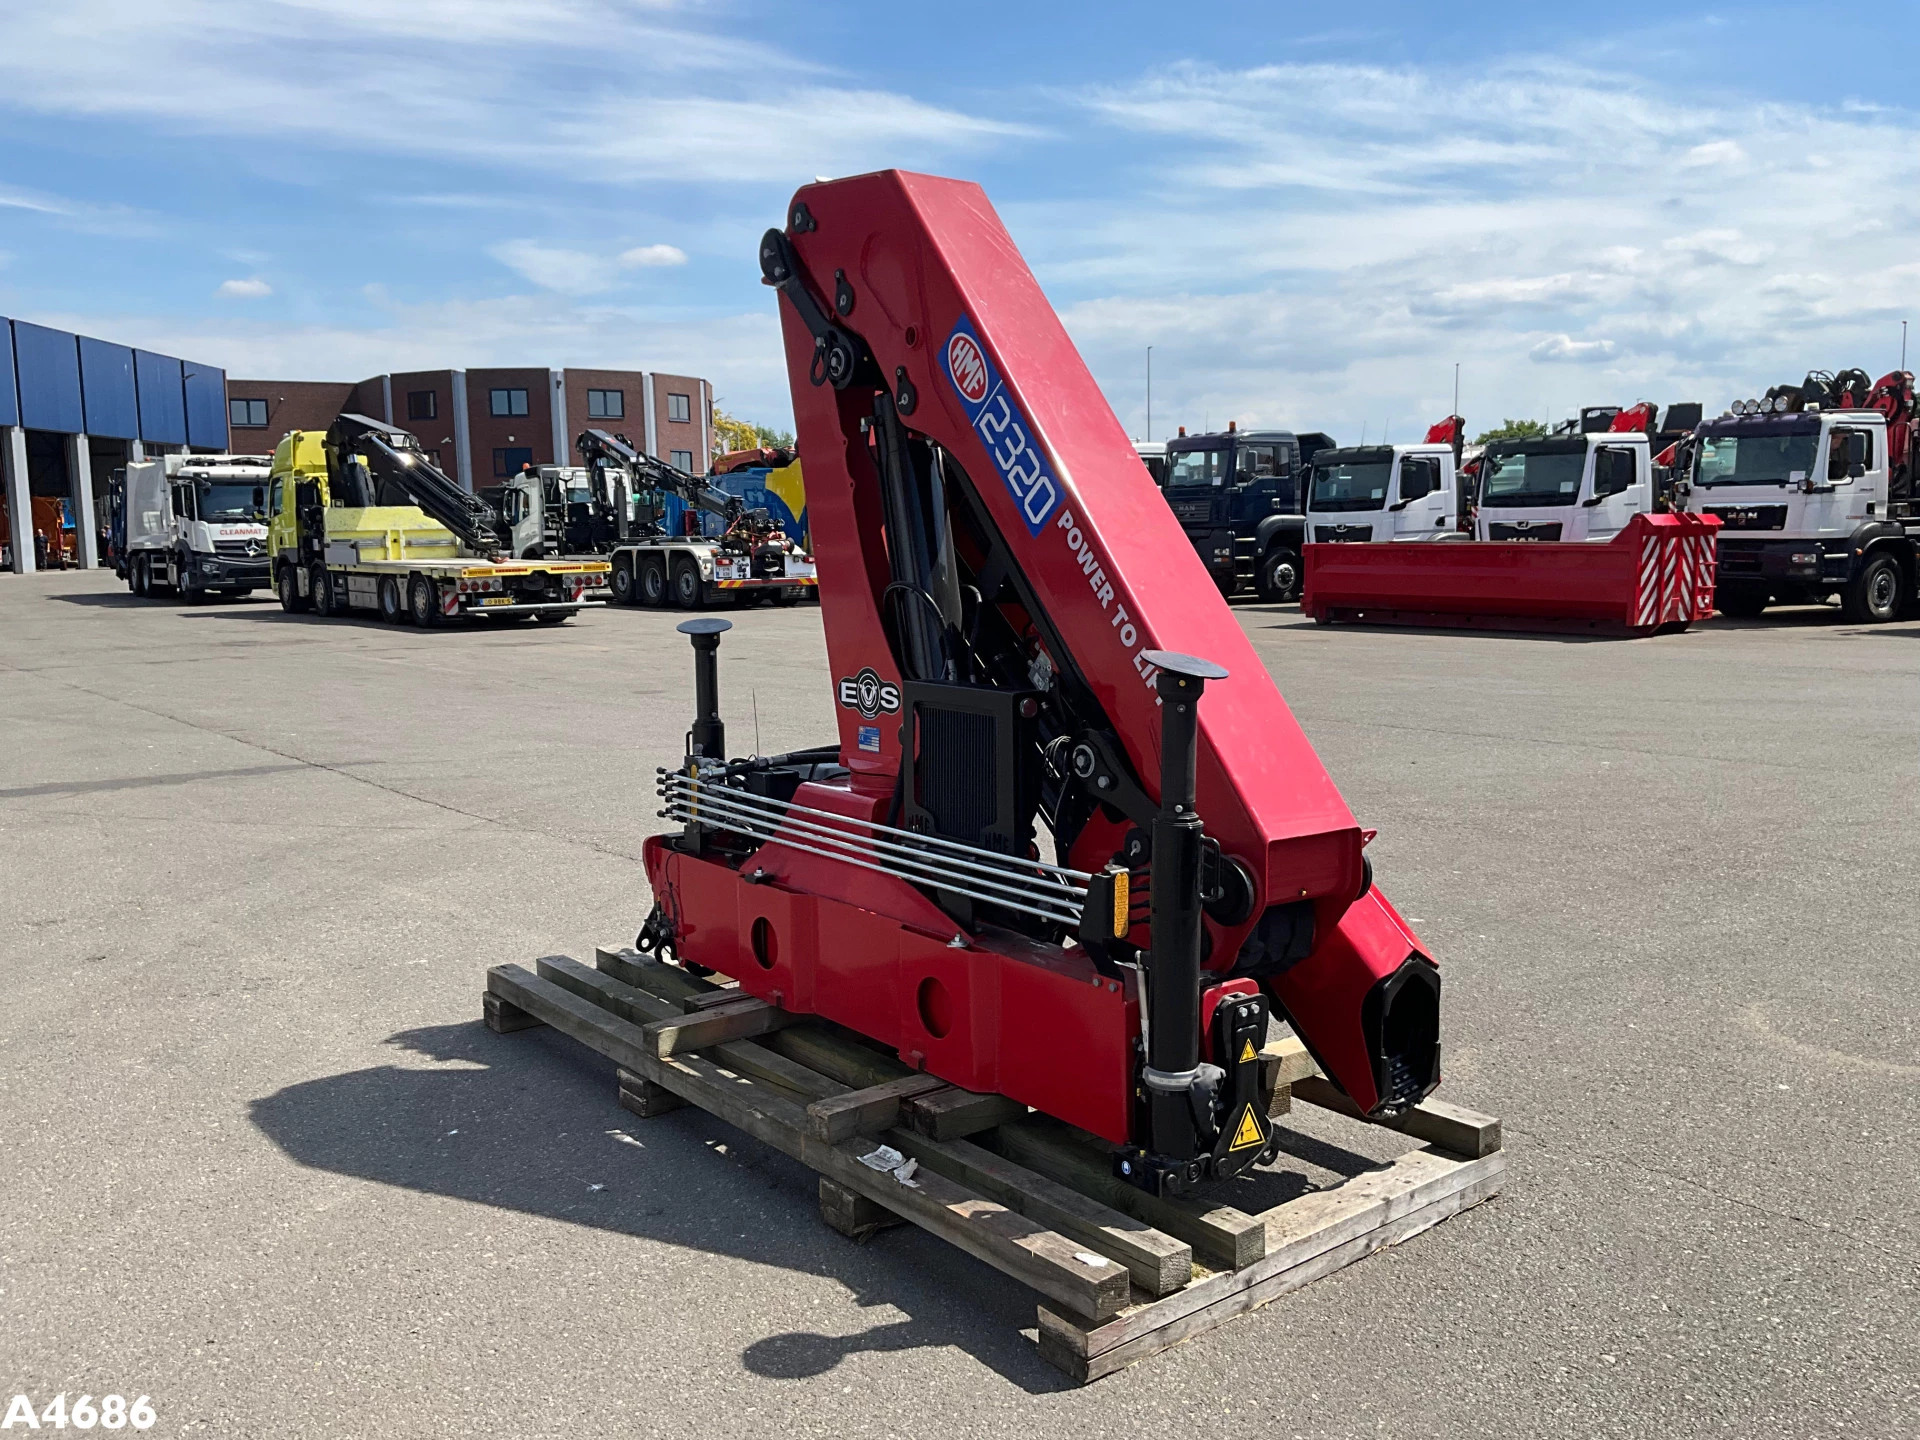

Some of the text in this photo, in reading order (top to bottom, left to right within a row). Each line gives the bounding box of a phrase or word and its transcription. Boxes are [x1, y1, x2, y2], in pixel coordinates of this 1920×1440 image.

[951, 338, 1057, 526] HMF 2320
[219, 528, 263, 536] CLEANMAT
[1727, 511, 1758, 519] MAN
[1056, 509, 1163, 707] POWER TO LIF
